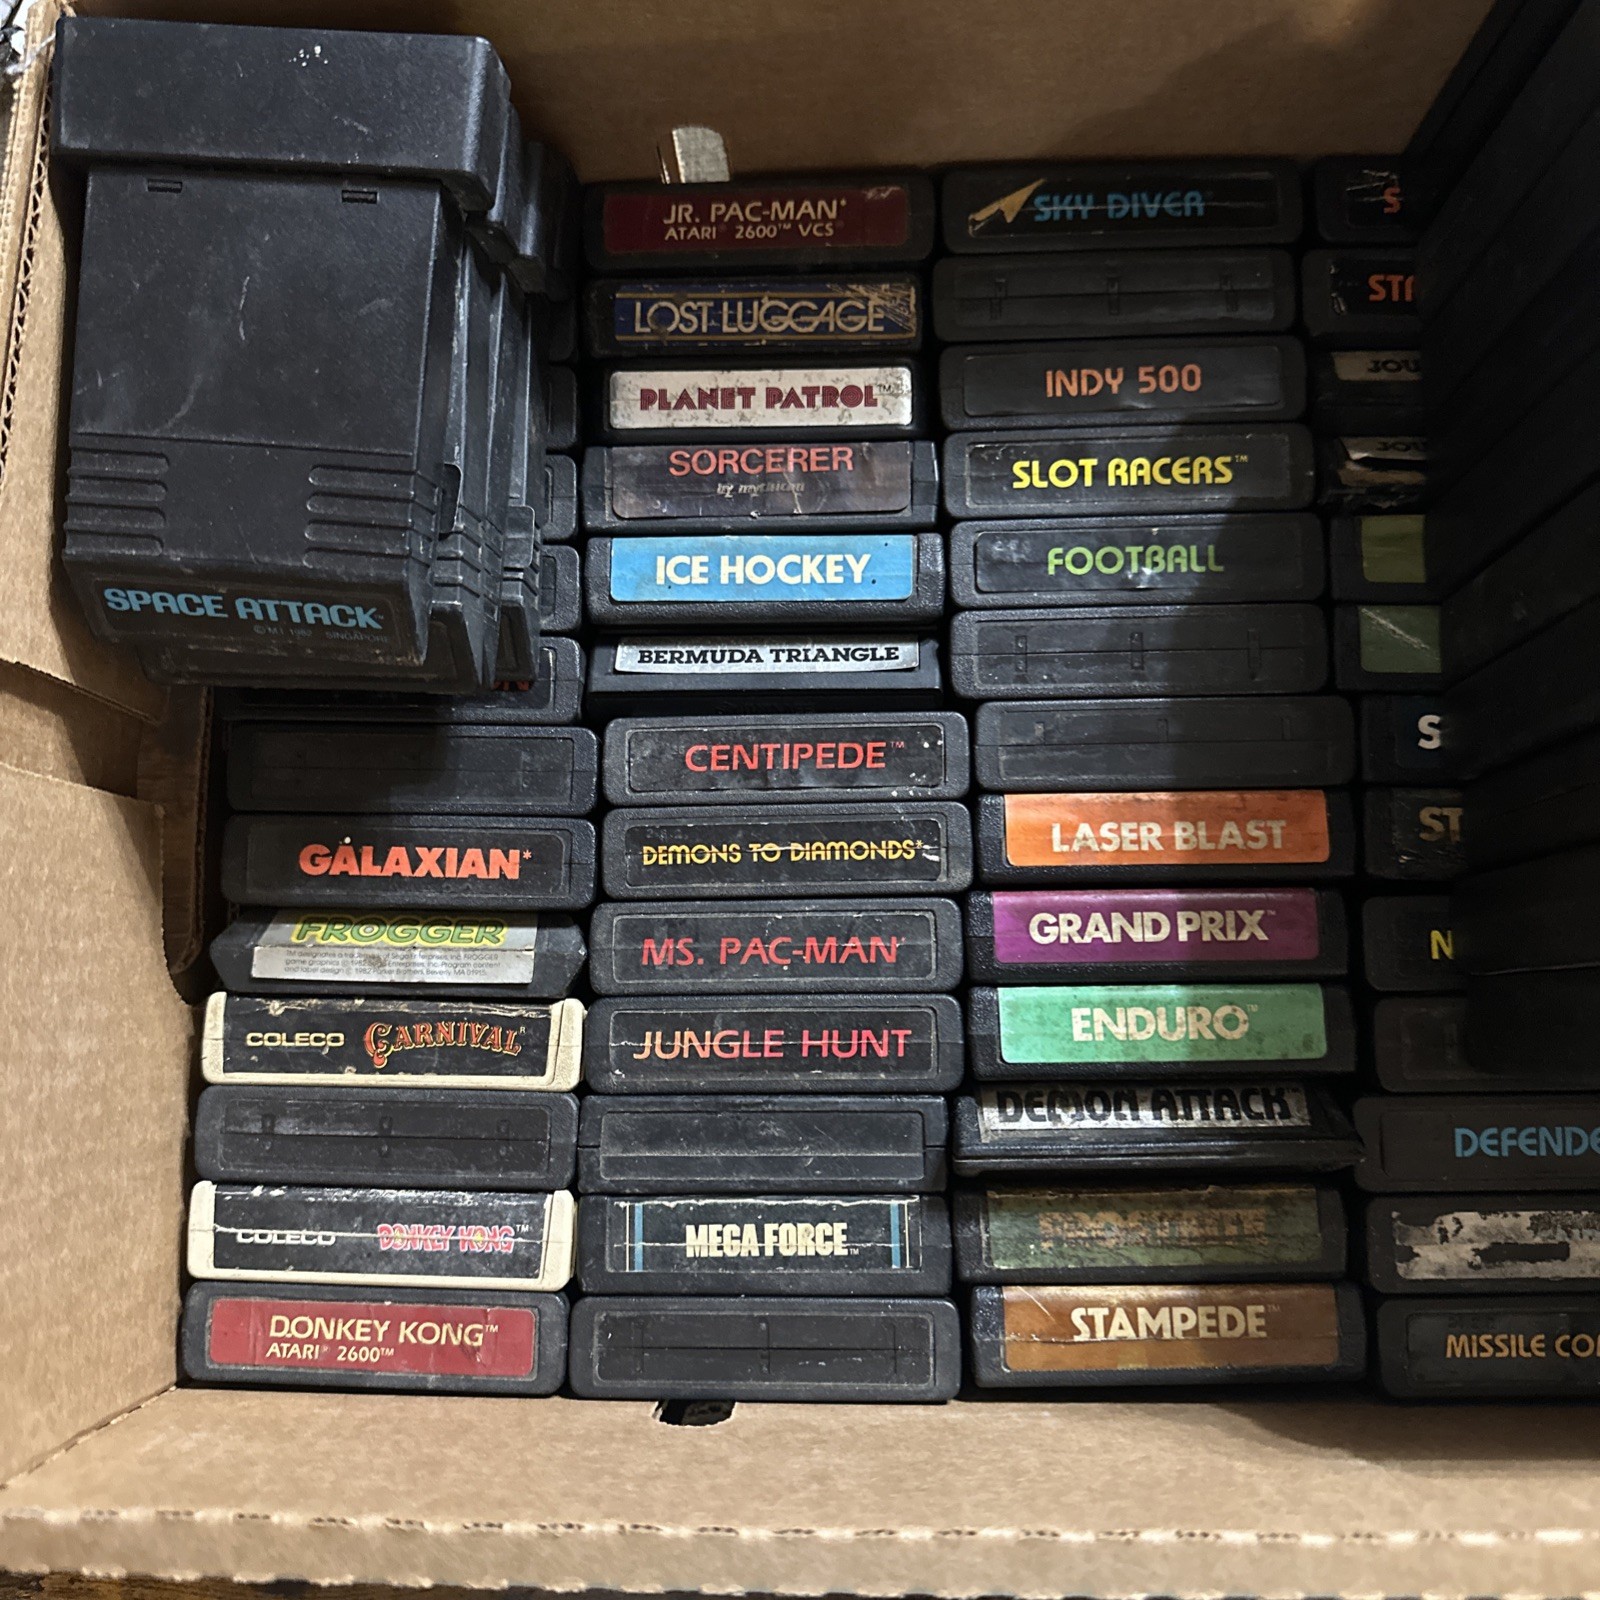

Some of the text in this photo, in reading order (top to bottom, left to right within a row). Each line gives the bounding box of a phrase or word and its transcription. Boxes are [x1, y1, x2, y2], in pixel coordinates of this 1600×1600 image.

[663, 204, 700, 226] JR.
[1033, 191, 1206, 222] SKY DIVER
[634, 299, 885, 333] LOST LUGGAGE
[1046, 364, 1202, 398] INDY 500
[640, 387, 757, 412] PLANET
[668, 446, 854, 477] SORCERER
[1012, 458, 1099, 489] SLOT
[655, 553, 871, 586] ICE HOCKEY
[1047, 544, 1225, 577] FOOTBALL
[103, 587, 228, 618] SPACE
[637, 646, 900, 665] BERMUDA TRIANGLE
[1051, 819, 1287, 854] LASER BLAST
[642, 843, 742, 866] DEMONS
[748, 843, 782, 862] TO
[294, 915, 506, 946] FROGGER
[1028, 911, 1172, 945] GRAND
[641, 937, 704, 966] MS.
[246, 1032, 345, 1048] COLECO
[633, 1029, 912, 1060] JUNGLE HUNT
[997, 1090, 1141, 1122] DEMON
[236, 1228, 336, 1246] COLECO
[377, 1223, 456, 1252] DONKEY
[685, 1223, 761, 1258] MEGA
[269, 1314, 390, 1342] DONKEY
[1445, 1333, 1600, 1359] MISSILE CO
